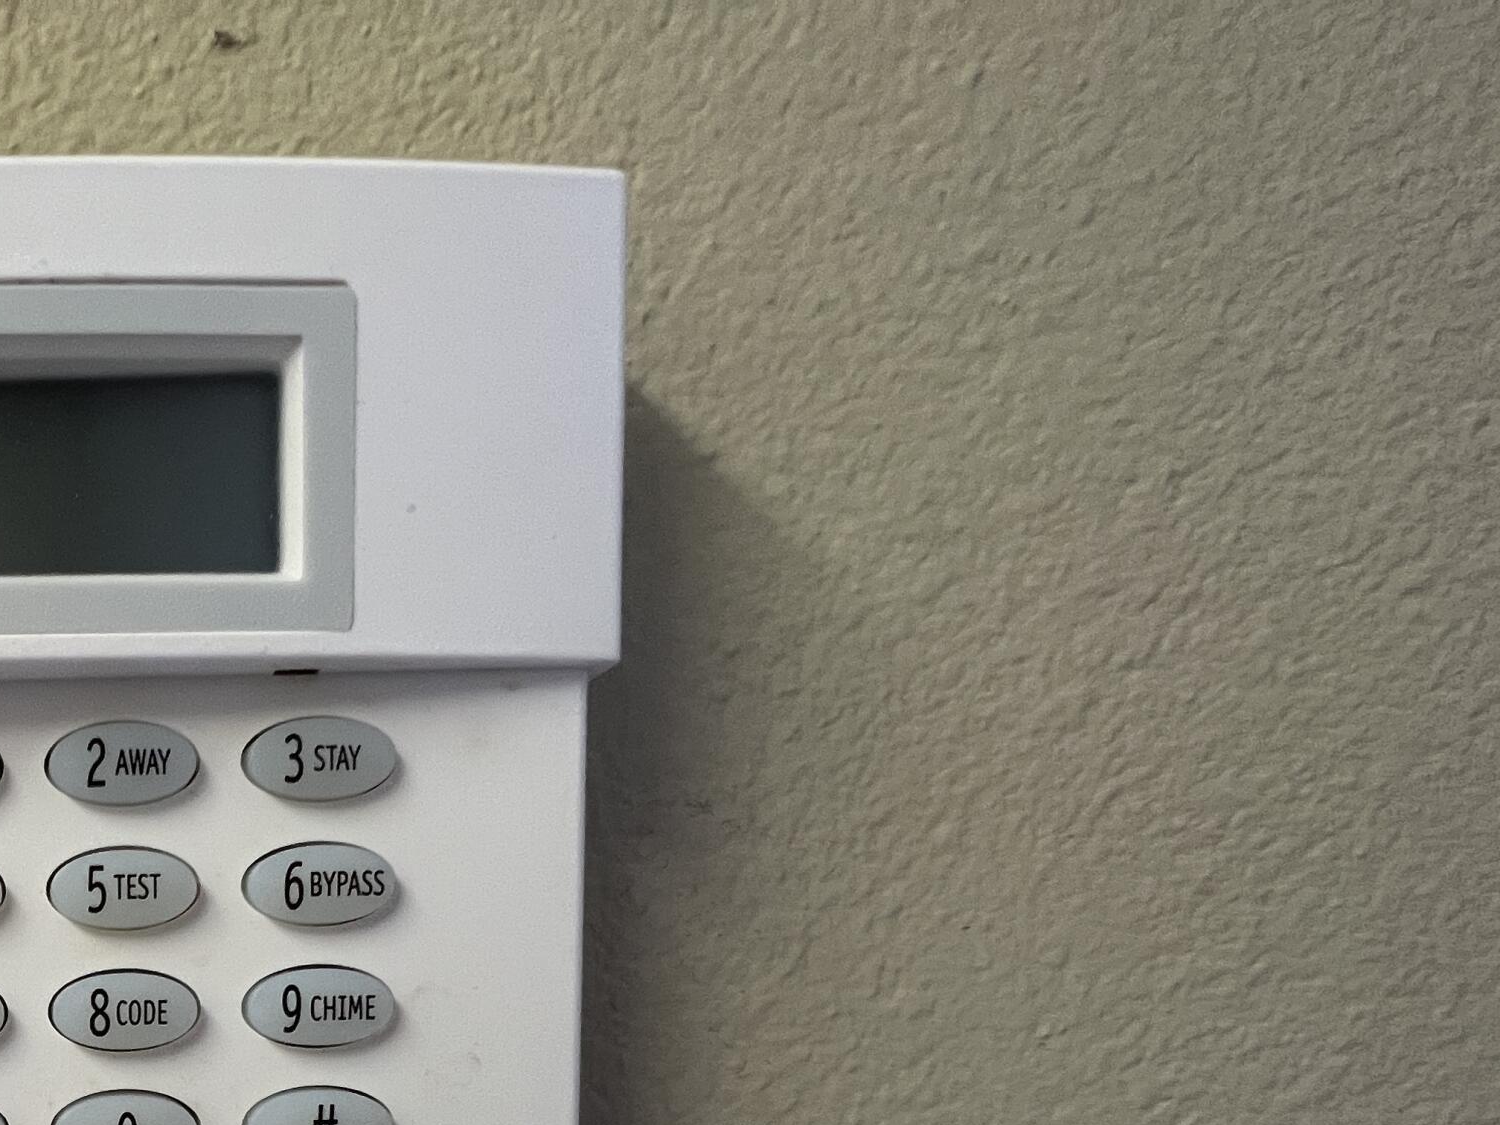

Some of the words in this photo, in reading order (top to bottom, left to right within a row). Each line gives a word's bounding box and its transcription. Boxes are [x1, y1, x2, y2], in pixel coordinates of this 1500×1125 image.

[85, 737, 106, 788] 2
[115, 748, 171, 776] AWAY
[284, 733, 304, 783] 3
[312, 744, 361, 772] STAY
[86, 865, 106, 914] 5
[113, 873, 161, 900] TEST
[283, 861, 304, 910] 6
[310, 871, 385, 897] BYPASS
[89, 989, 110, 1037] 8
[116, 999, 168, 1026] CODE
[282, 984, 302, 1033] 9
[310, 995, 376, 1022] CHIME
